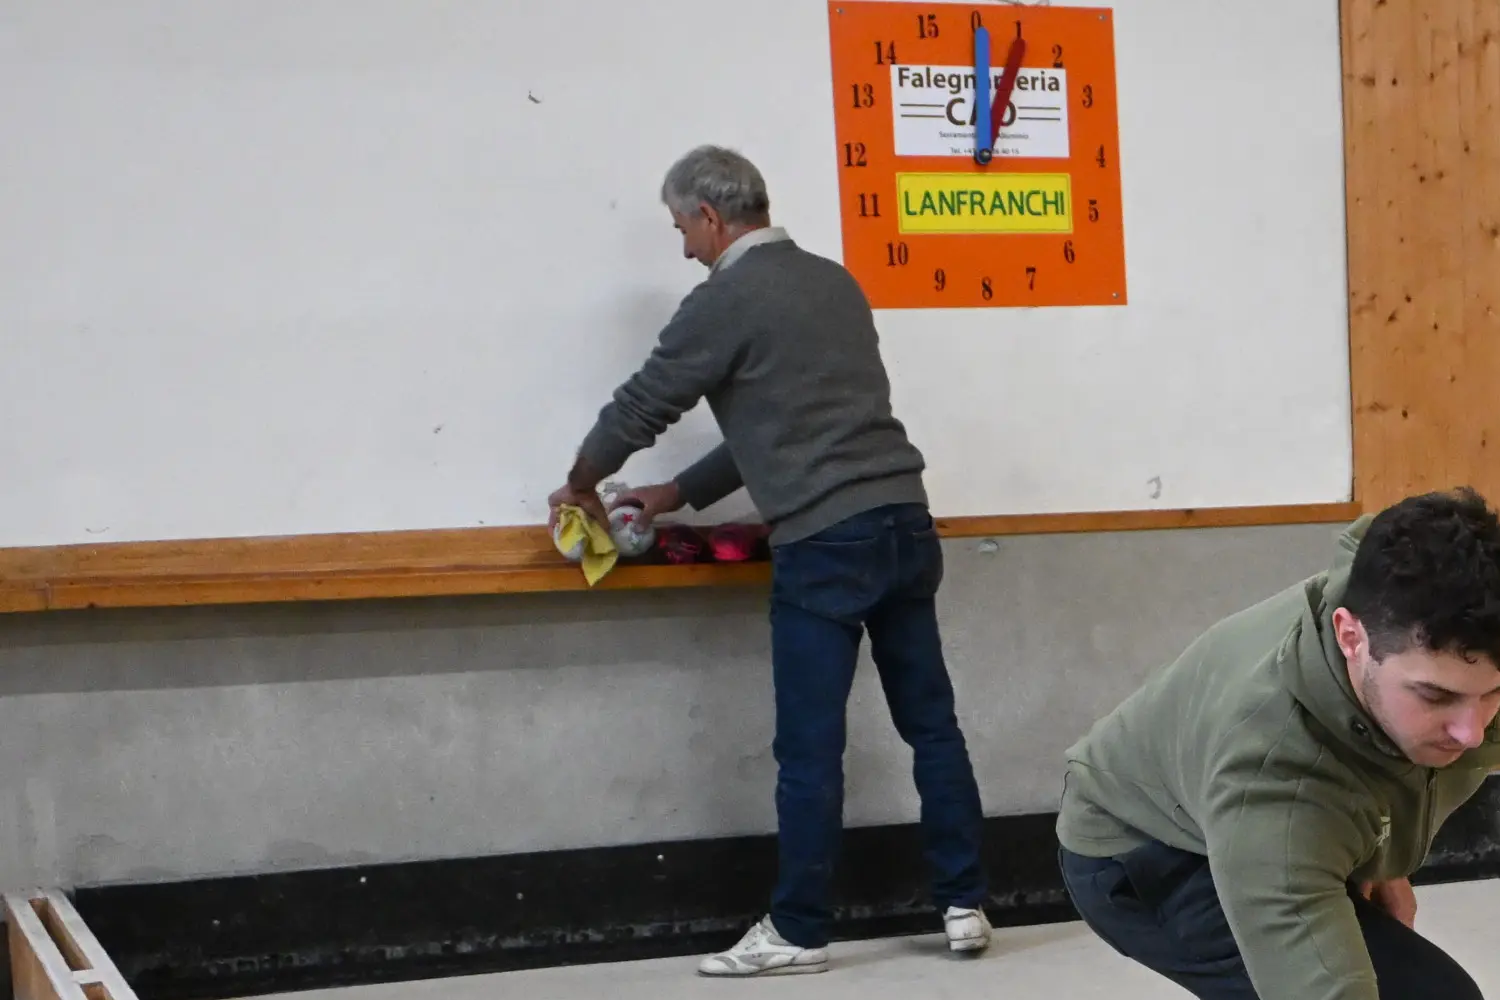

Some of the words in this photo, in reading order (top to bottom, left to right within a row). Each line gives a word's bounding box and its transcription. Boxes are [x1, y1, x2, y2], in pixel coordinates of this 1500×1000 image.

[917, 15, 938, 39] 15
[875, 41, 896, 65] 14
[1052, 45, 1063, 68] 2
[897, 67, 1060, 94] Falegneria
[852, 84, 873, 108] 13
[1083, 85, 1093, 108] 3
[845, 143, 866, 167] 12
[1096, 144, 1105, 168] 4
[859, 194, 880, 217] 11
[904, 190, 1064, 216] LANFRANCHI
[1088, 200, 1099, 222] 5
[887, 242, 908, 266] 10
[1064, 241, 1075, 264] 6
[935, 269, 946, 291] 9
[982, 277, 993, 300] 8
[1026, 268, 1036, 290] 7
